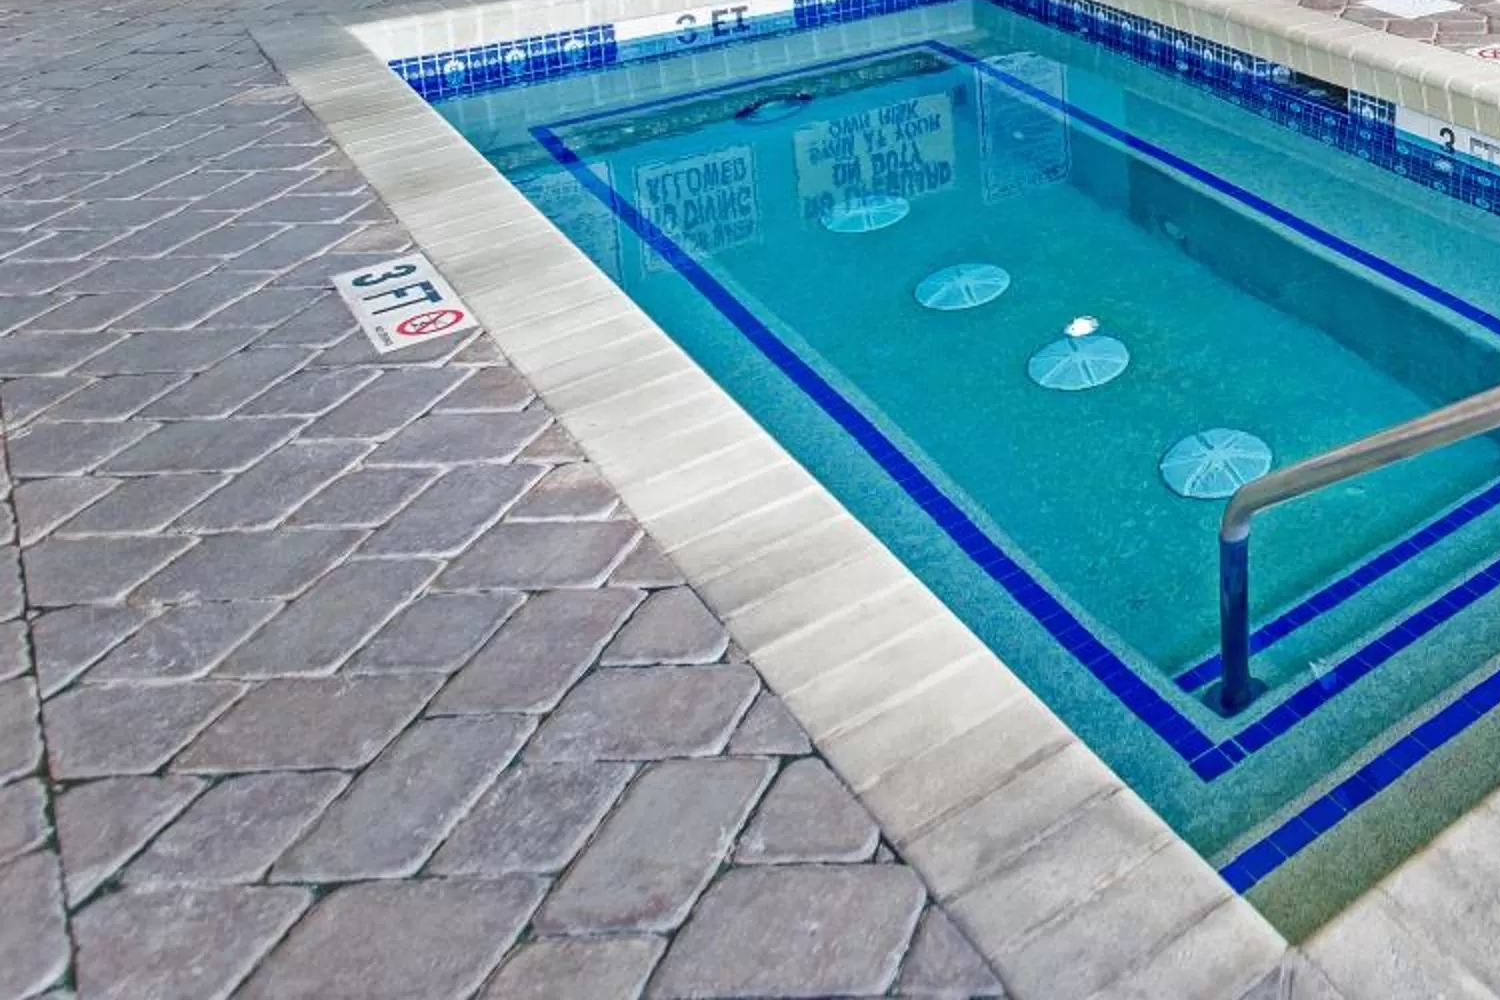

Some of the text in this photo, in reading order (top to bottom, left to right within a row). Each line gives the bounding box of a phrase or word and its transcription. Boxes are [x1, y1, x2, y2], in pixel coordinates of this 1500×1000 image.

[711, 5, 750, 37] FT
[1439, 126, 1456, 155] 3
[352, 263, 444, 316] 3 FT
